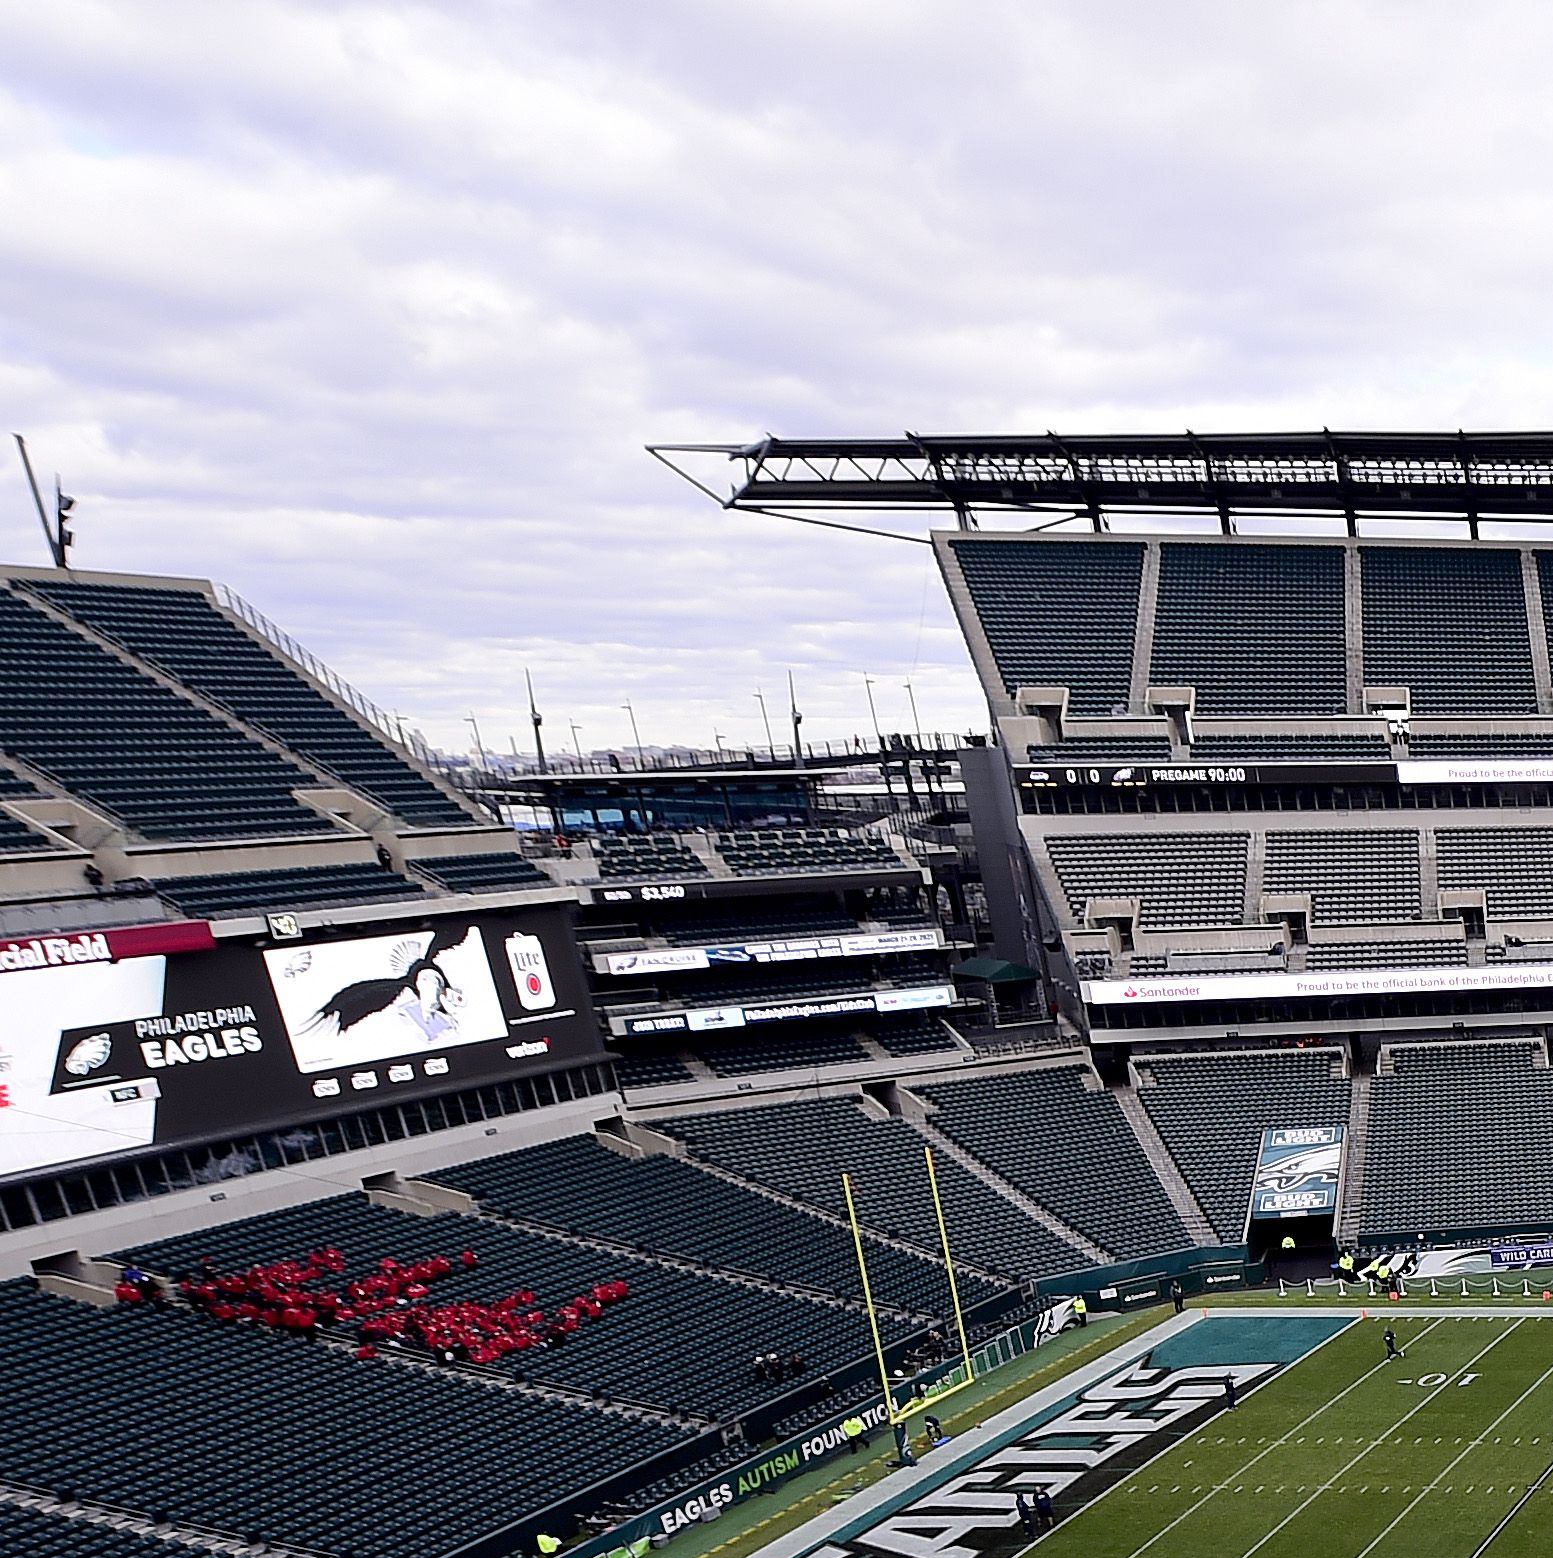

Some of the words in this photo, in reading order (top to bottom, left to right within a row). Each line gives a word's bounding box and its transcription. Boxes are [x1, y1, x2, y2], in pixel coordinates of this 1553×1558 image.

[1065, 769, 1077, 783] 0
[1089, 768, 1100, 783] 0
[1152, 769, 1207, 782] PREGAME
[1207, 768, 1246, 782] 90:00
[1448, 769, 1477, 777] Proud
[1492, 769, 1504, 777] be
[1506, 769, 1522, 777] the
[43, 933, 113, 965] Field
[513, 950, 540, 972] Lite
[1296, 981, 1328, 991] Proud
[1345, 980, 1358, 989] be
[1361, 979, 1379, 988] the
[1382, 977, 1417, 988] official
[1419, 977, 1446, 986] bank
[1461, 976, 1478, 985] the
[1481, 973, 1544, 985] Philadelphia
[1139, 985, 1201, 998] Santander
[136, 1005, 257, 1039] PHILADELPHIA
[140, 1027, 263, 1069] EAGLES
[1499, 1250, 1527, 1262] WILD
[1413, 1373, 1485, 1388] 10
[660, 1483, 734, 1534] EAGLES
[737, 1448, 800, 1496] AUTISM
